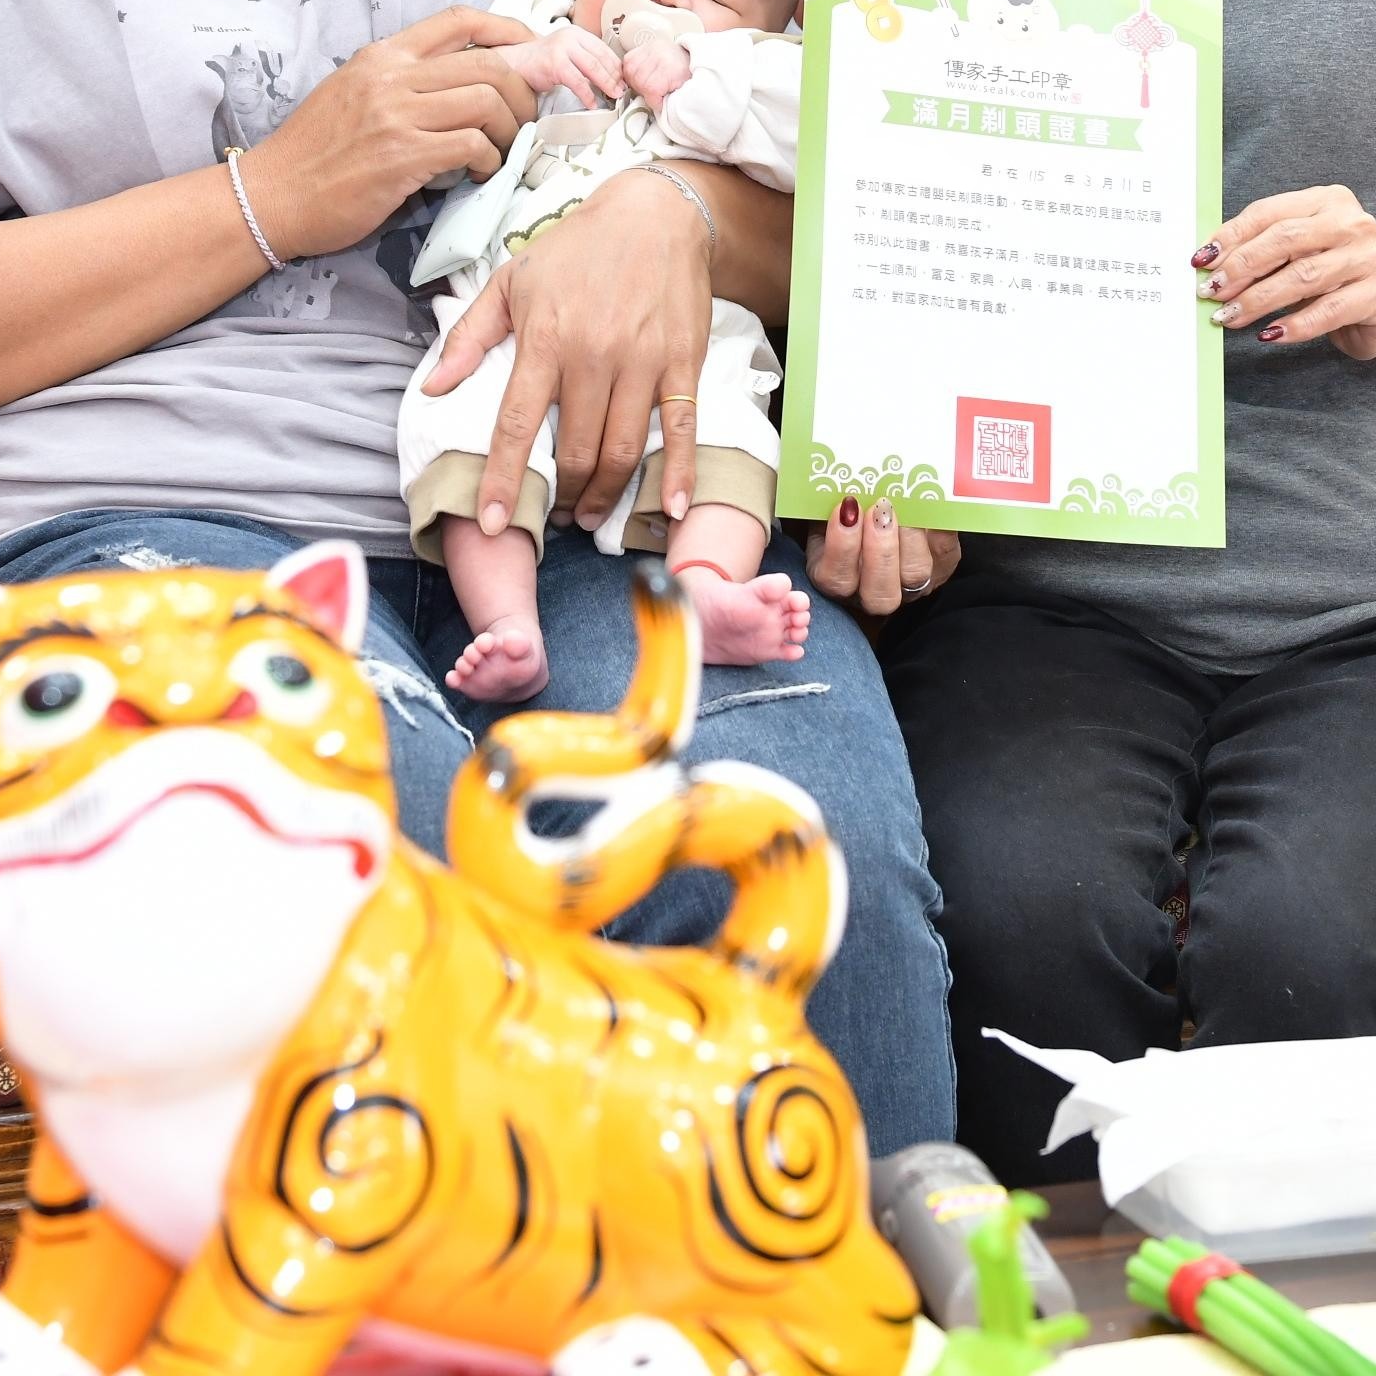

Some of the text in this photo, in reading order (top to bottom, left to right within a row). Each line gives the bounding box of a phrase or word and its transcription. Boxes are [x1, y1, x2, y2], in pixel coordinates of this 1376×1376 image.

[944, 59, 1073, 92] 傳家手工印章
[946, 80, 1069, 103] www.seals.com.tw
[912, 97, 1112, 146] 滿月剃頭證書
